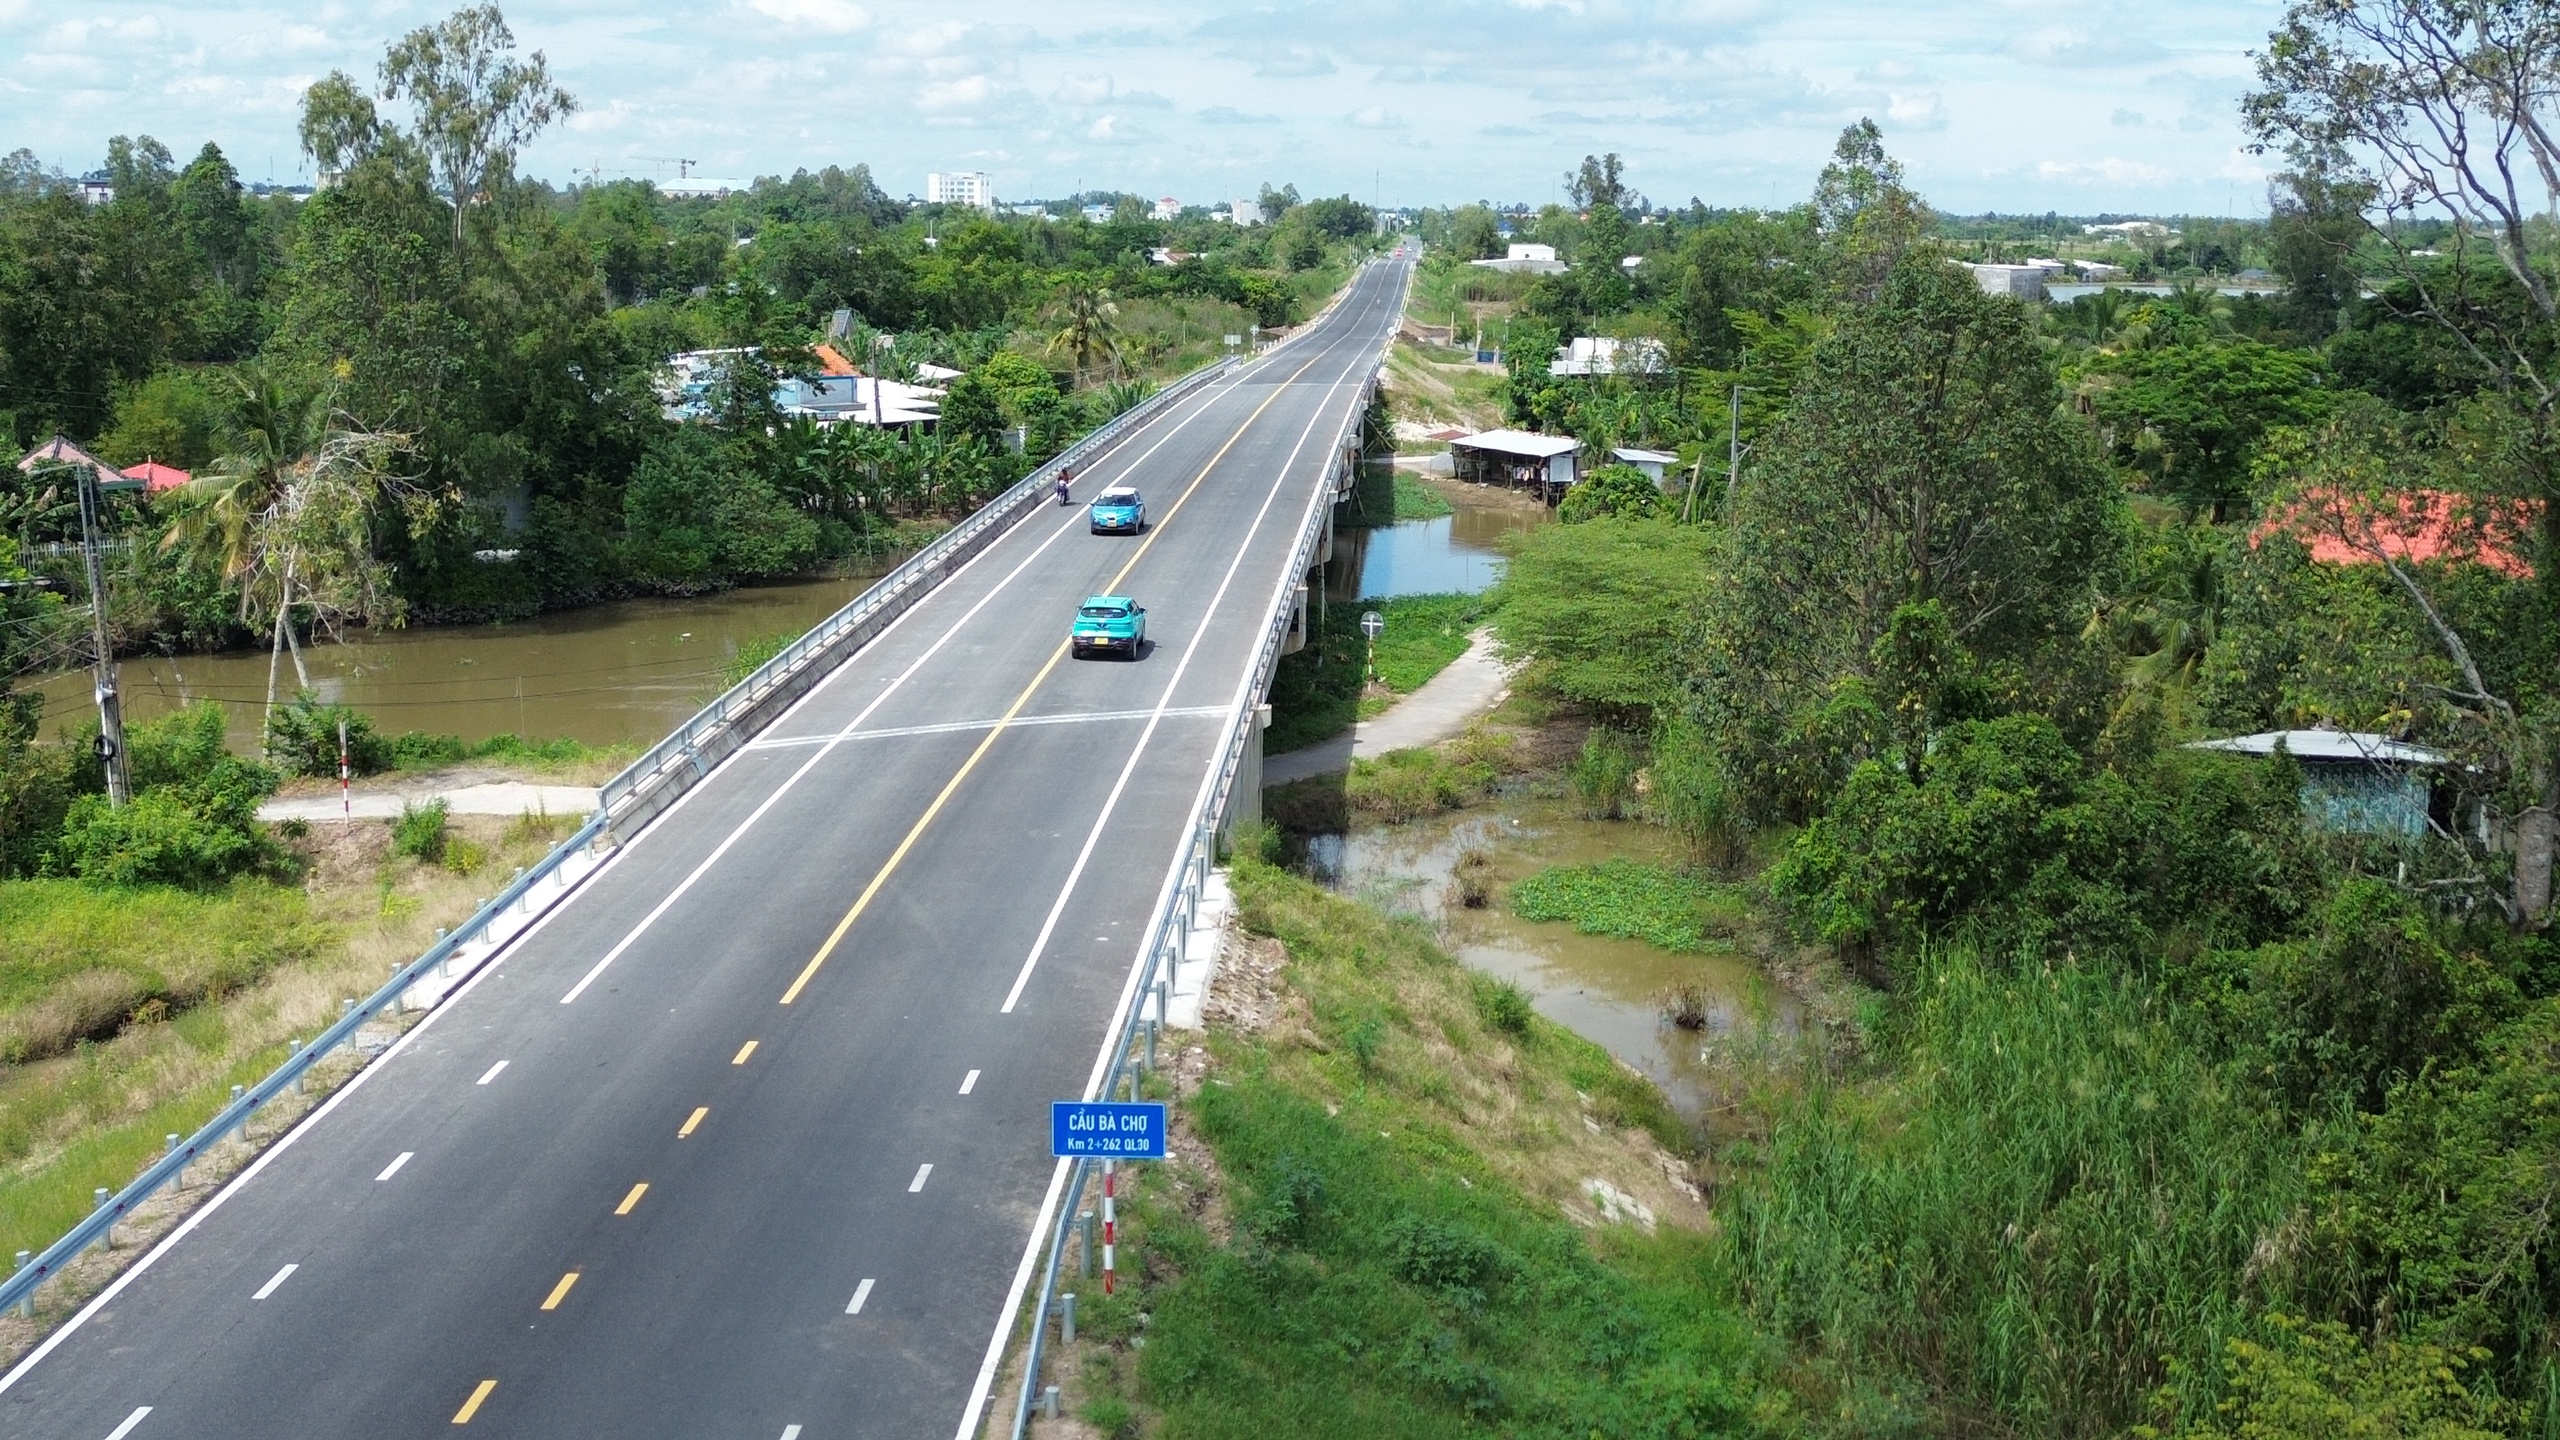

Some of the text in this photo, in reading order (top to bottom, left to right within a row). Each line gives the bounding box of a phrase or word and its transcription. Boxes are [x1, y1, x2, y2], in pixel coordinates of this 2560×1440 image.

[1069, 1107, 1148, 1134] CẦU BÀ CHỢ
[1067, 1137, 1150, 1151] Km 2+262 QL30
